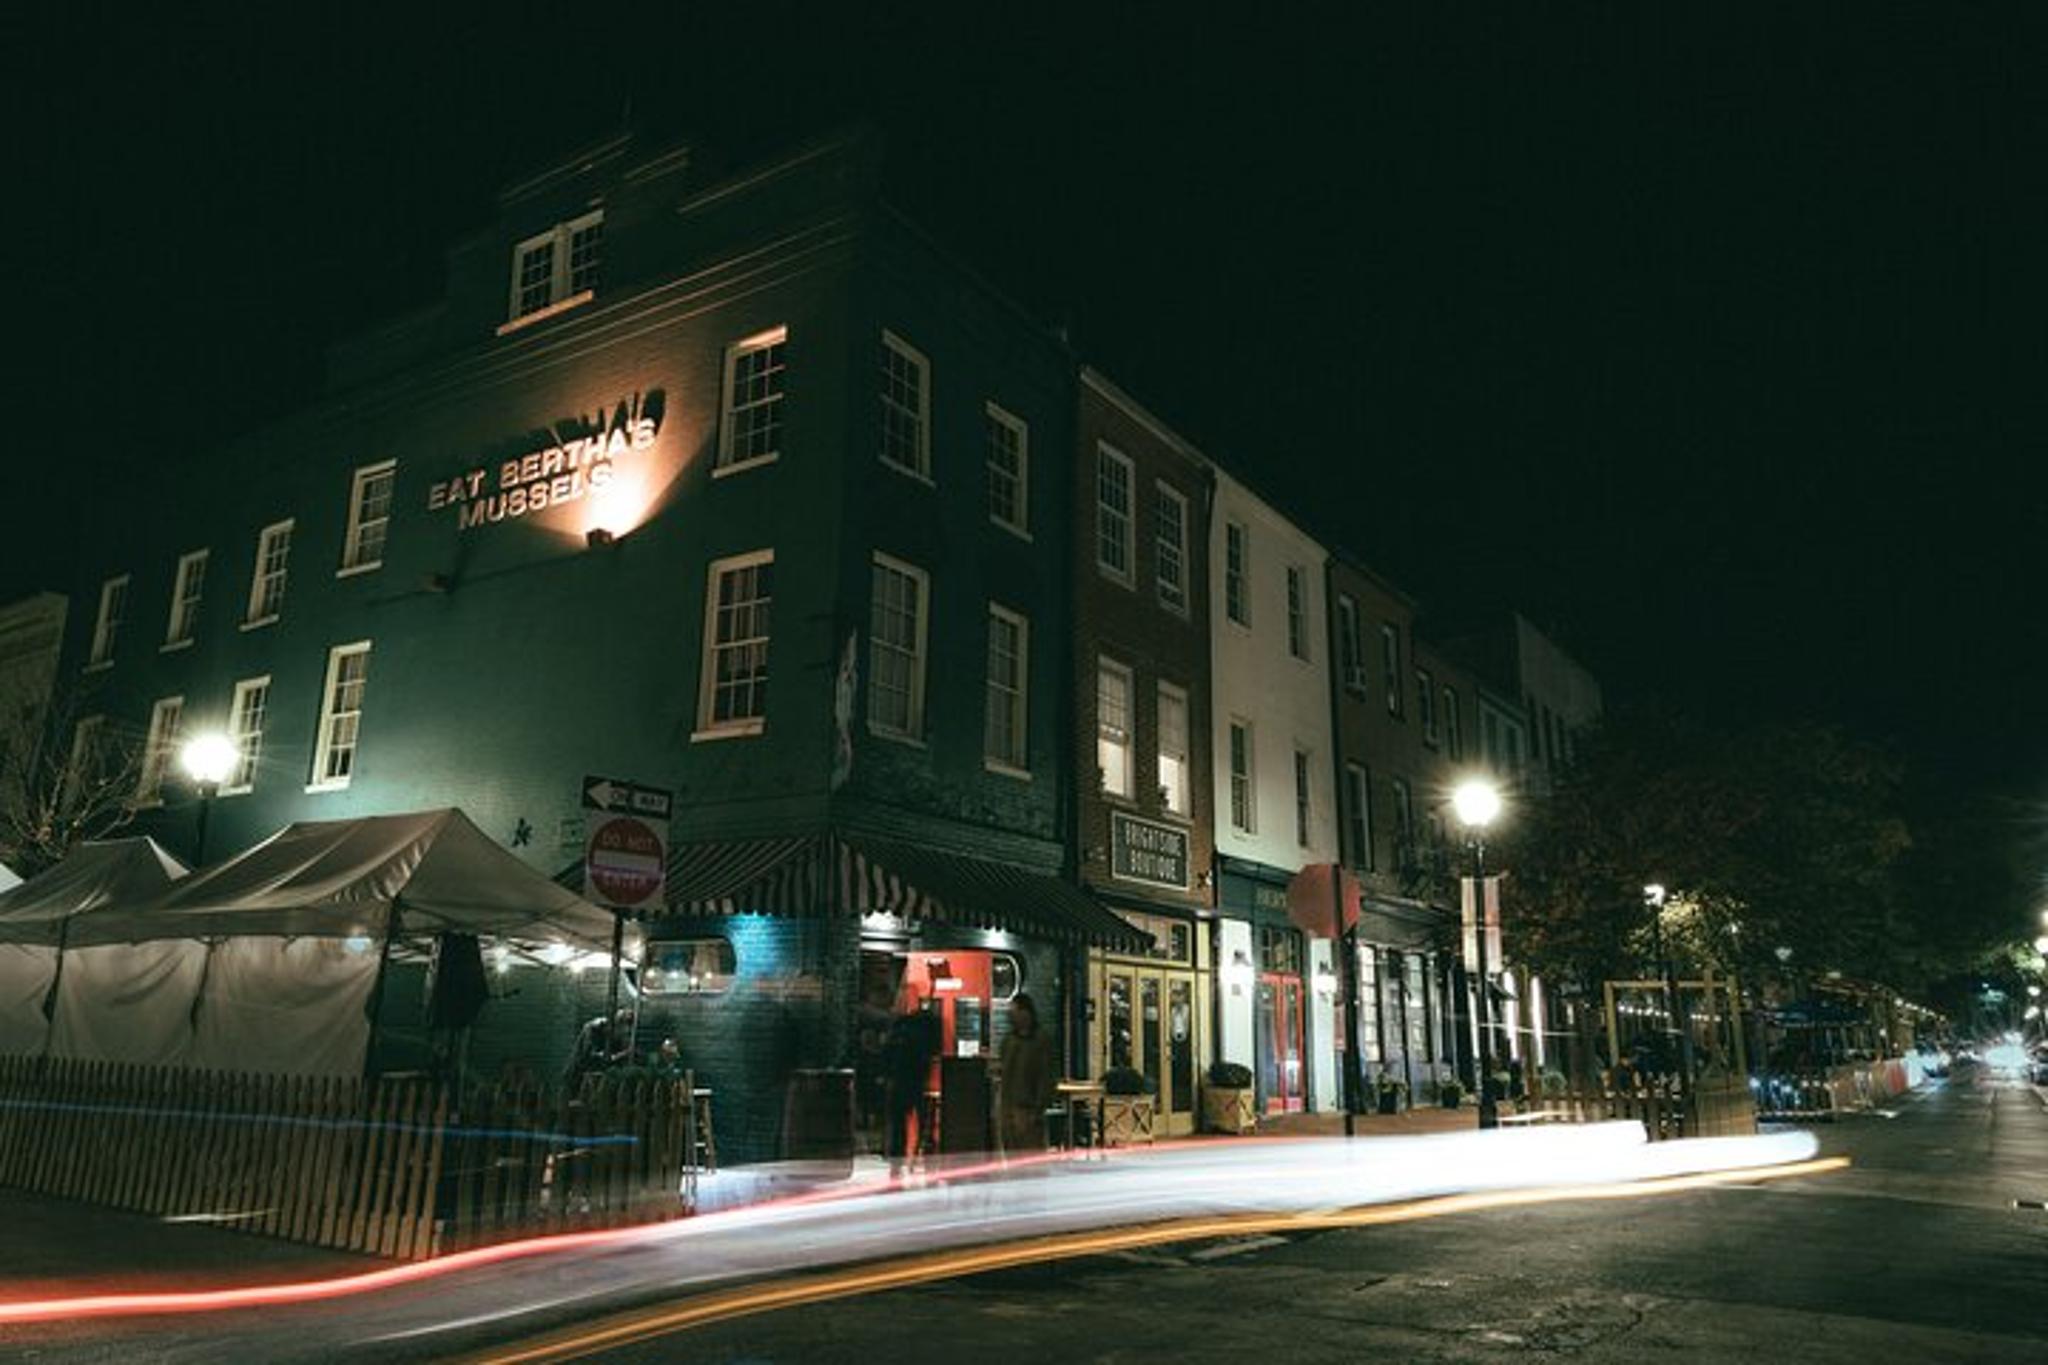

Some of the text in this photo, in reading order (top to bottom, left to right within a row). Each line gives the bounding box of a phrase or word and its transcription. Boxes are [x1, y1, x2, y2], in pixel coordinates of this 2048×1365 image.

[427, 417, 656, 510] EAT BERTHA'S
[457, 461, 613, 531] MUSSELS
[601, 830, 657, 852] DO NOT
[1131, 848, 1178, 881] BOUTIQUE
